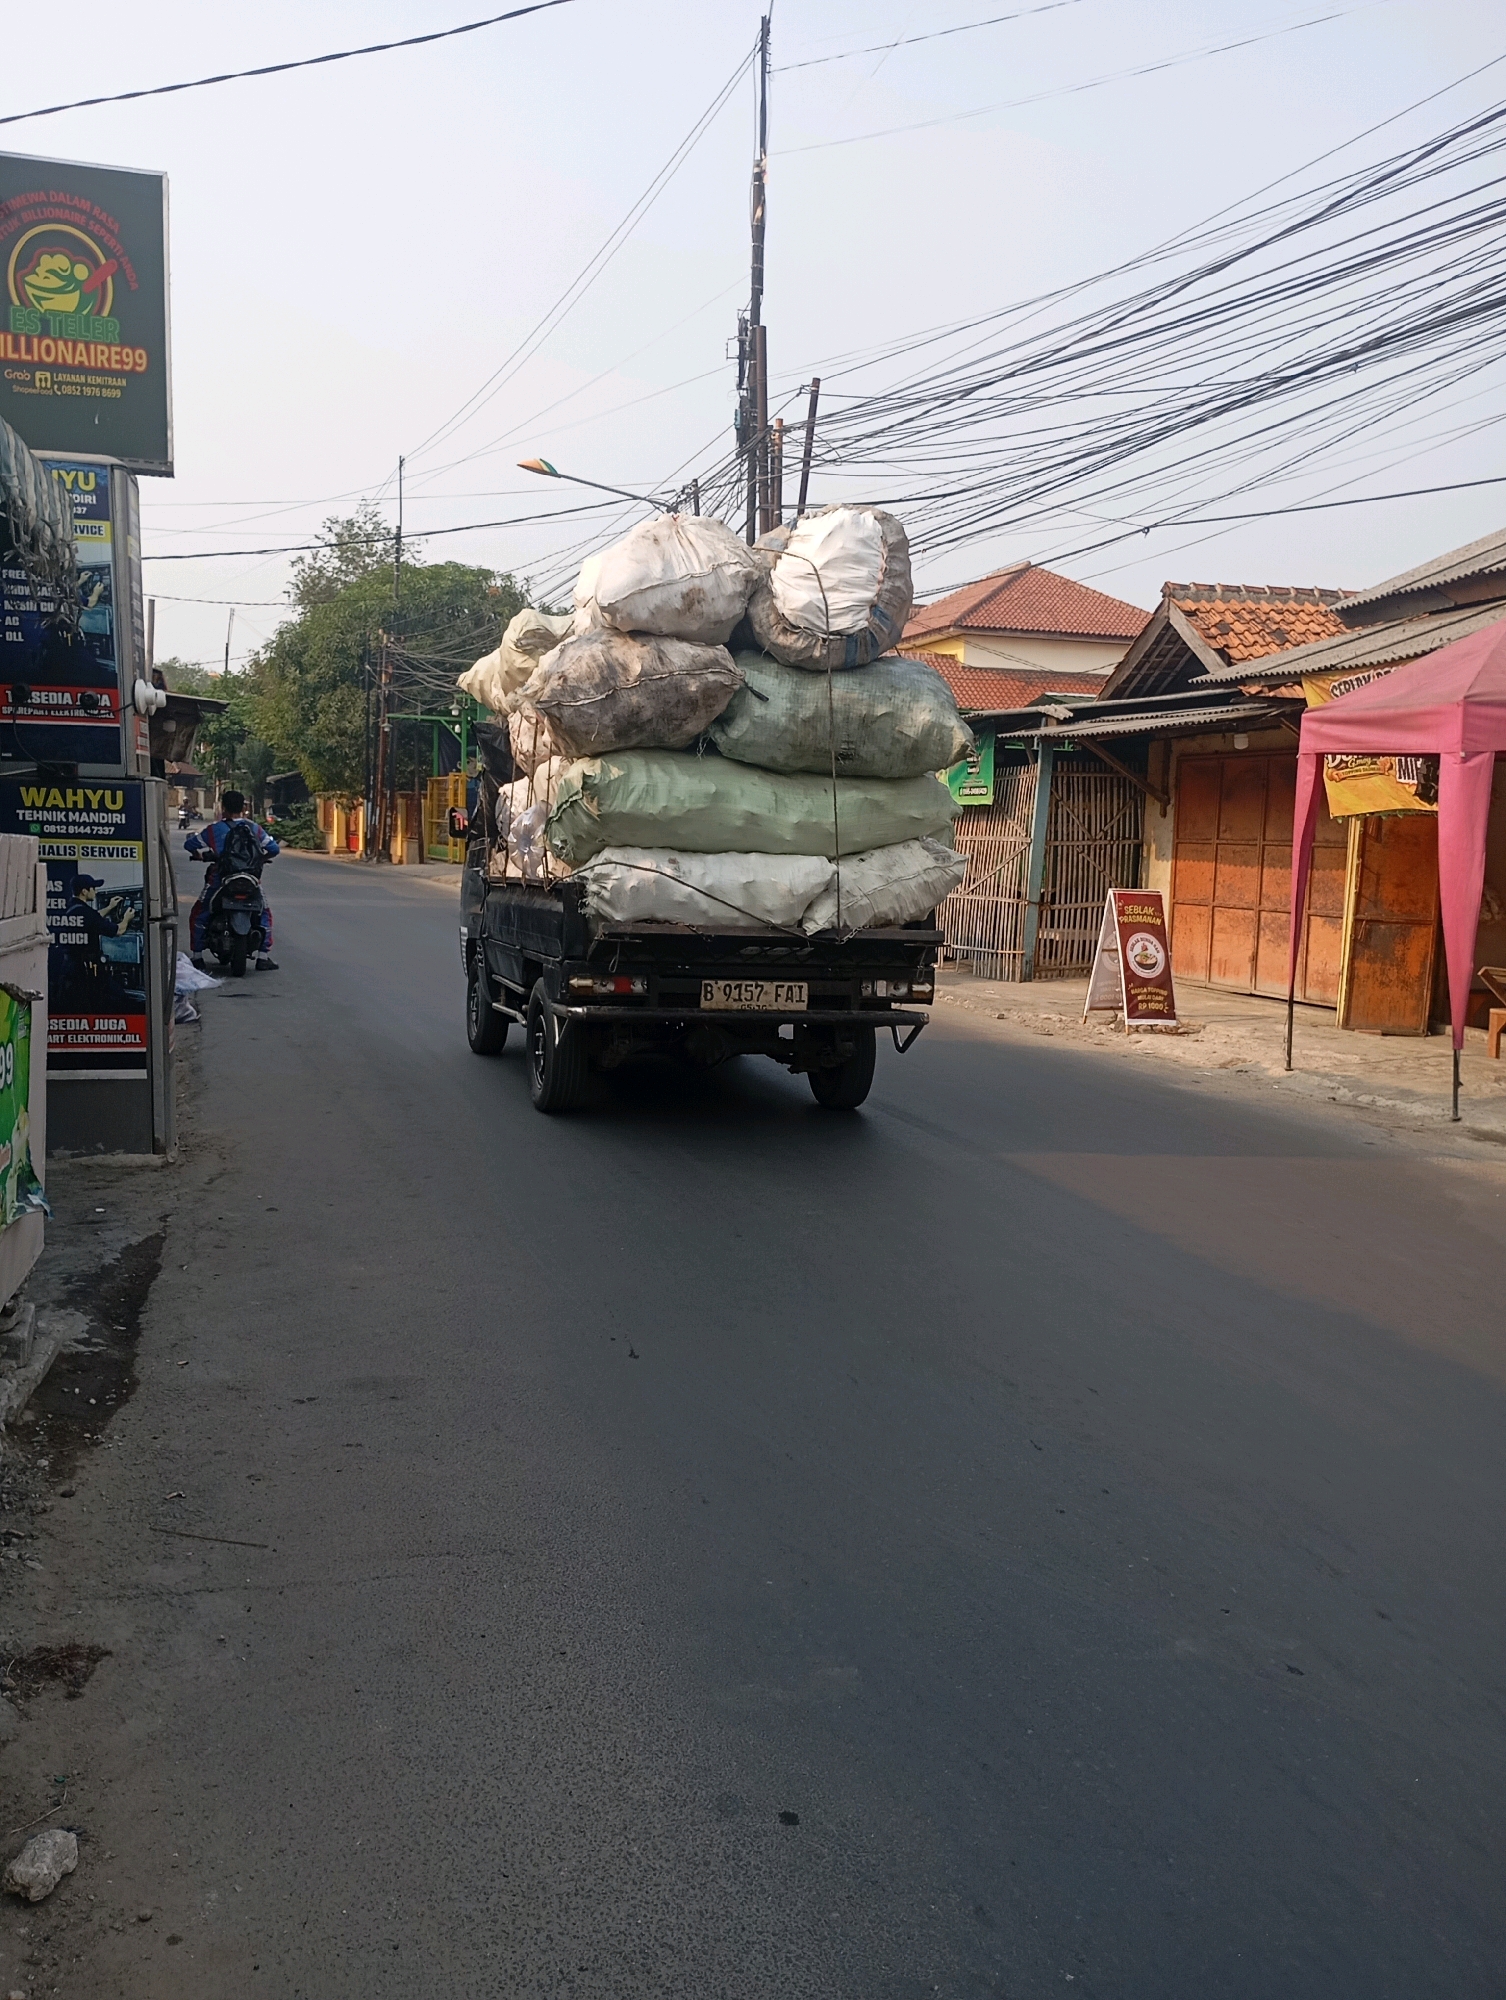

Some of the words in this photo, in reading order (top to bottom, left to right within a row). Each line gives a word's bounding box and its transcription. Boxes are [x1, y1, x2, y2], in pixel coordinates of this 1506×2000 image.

[49, 190, 92, 213] DALAM
[92, 206, 120, 234] RASA
[21, 207, 87, 226] BILLIONAIRE
[87, 220, 124, 256] SEPERTI
[120, 256, 139, 291] ANDA
[10, 306, 41, 335] ES
[46, 310, 121, 343] TELER
[4, 369, 31, 381] Grab
[53, 373, 86, 383] LAYANAN
[87, 375, 127, 387] KEMITRAAN
[61, 385, 81, 396] 0852
[71, 494, 97, 504] DIRI
[6, 631, 24, 642] DLL
[6, 690, 73, 705] TSEDIA
[20, 786, 124, 810] WAHYU
[16, 809, 67, 822] TEHNIK
[68, 811, 126, 824] MANDIRI
[43, 824, 67, 834] 0812
[68, 825, 92, 835] 8144
[92, 826, 115, 835] 7337
[81, 845, 137, 859] SERVICE
[1124, 905, 1155, 915] SEBLAK
[1120, 915, 1162, 926] PRASMANAN
[59, 932, 89, 945] CUCI
[703, 983, 714, 1002] B
[723, 983, 764, 1002] 9157
[775, 984, 805, 1003] FAI
[1138, 1002, 1148, 1011] RP
[1147, 1002, 1164, 1011] 1000
[48, 1018, 90, 1031] SEDIA
[92, 1018, 127, 1031] JUGA
[67, 1034, 142, 1044] ELEKTRONIK,DLL
